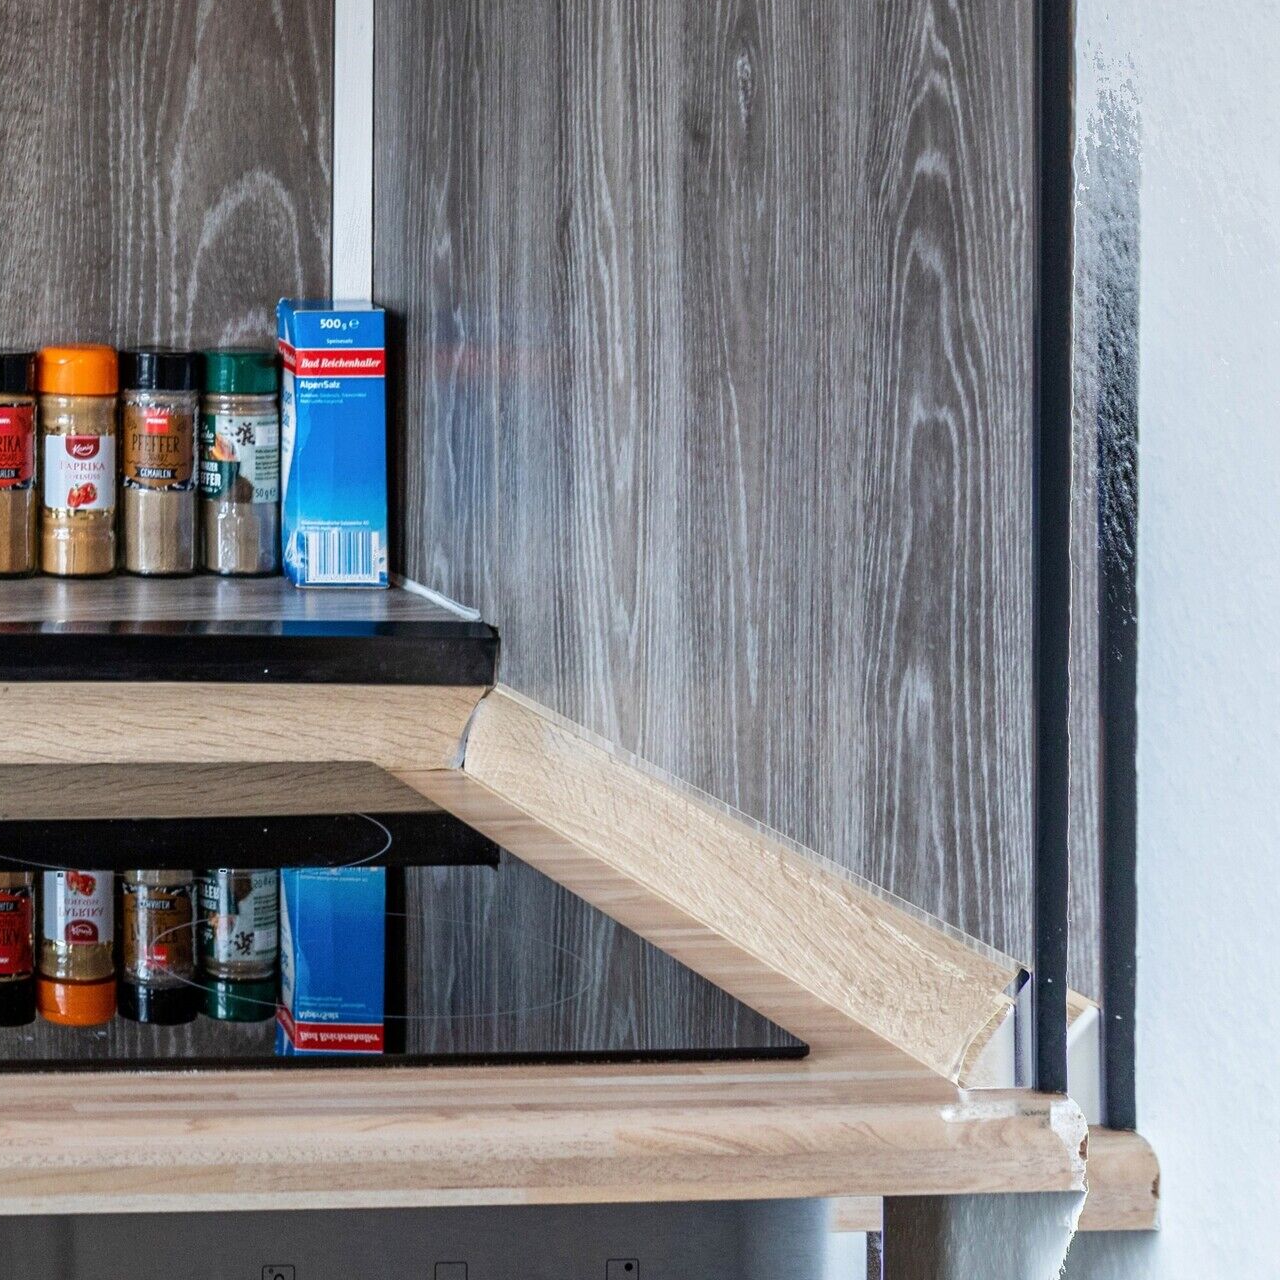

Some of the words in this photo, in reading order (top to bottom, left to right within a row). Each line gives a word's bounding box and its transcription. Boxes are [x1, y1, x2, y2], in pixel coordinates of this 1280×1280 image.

[320, 319, 341, 329] 500
[301, 357, 320, 369] Bad
[321, 357, 381, 368] Reichenhaller
[132, 434, 180, 453] PFEFFER
[60, 462, 106, 471] PAPRIKA
[140, 467, 172, 478] GEMAHLEN
[255, 488, 263, 498] 50
